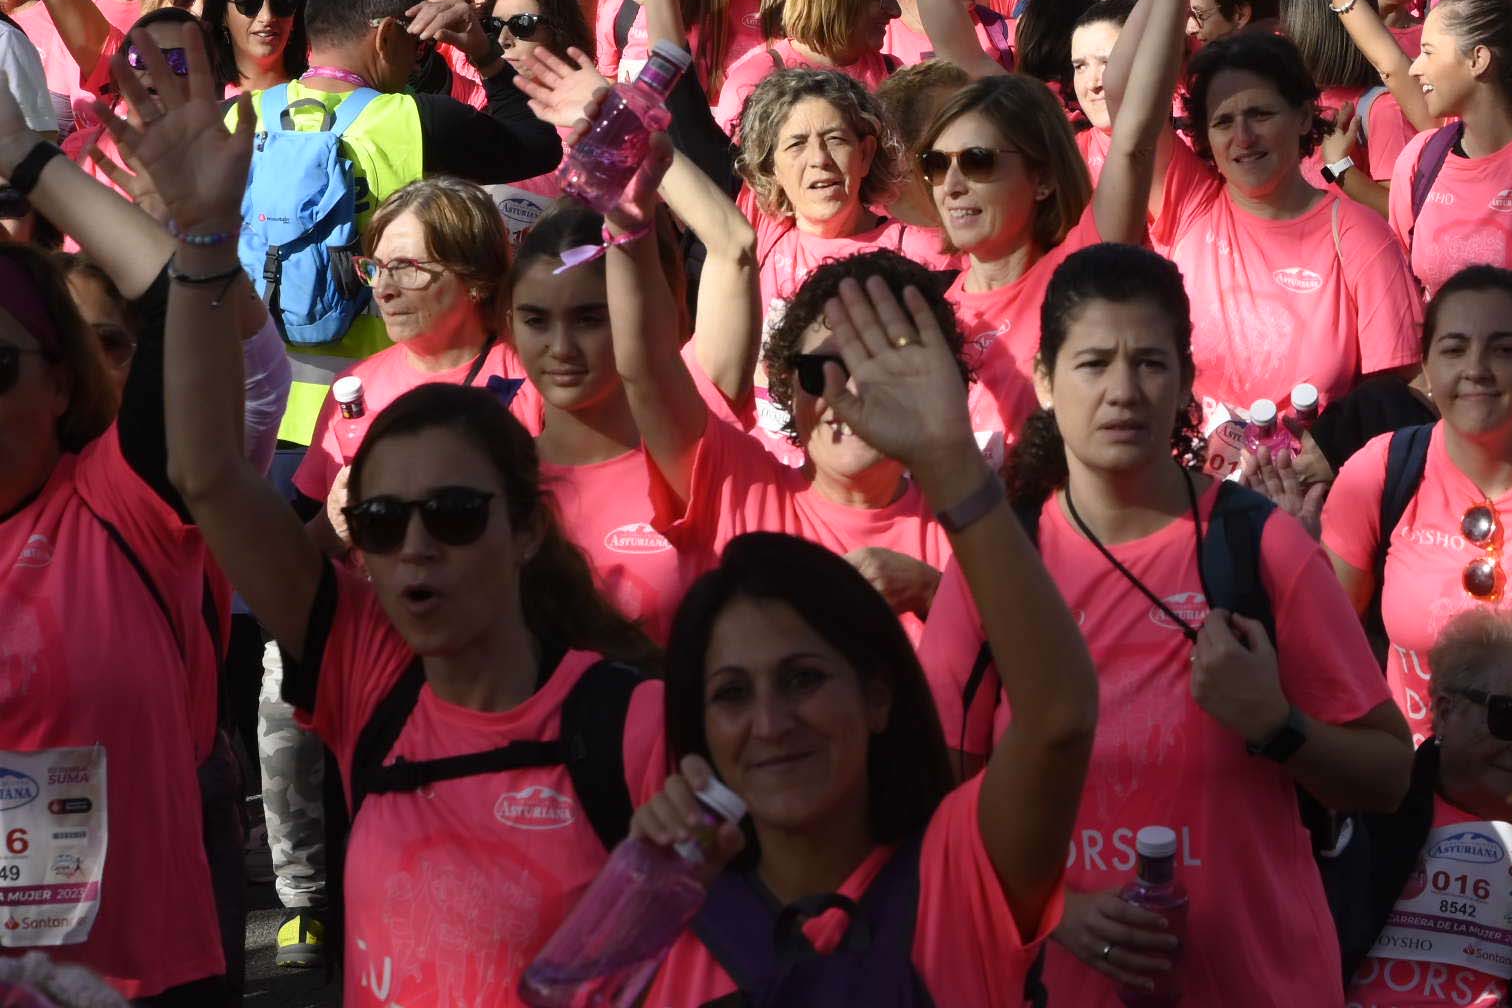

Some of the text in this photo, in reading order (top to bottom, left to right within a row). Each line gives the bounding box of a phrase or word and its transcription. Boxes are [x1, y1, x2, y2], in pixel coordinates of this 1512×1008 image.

[500, 800, 571, 820] ASTURIANA
[1436, 845, 1499, 859] ASTURIANA
[1431, 870, 1491, 900] 016
[8, 892, 52, 902] MUJER
[1439, 899, 1477, 918] 8542
[1468, 925, 1503, 940] MUJER
[1379, 934, 1433, 952] OYSHO
